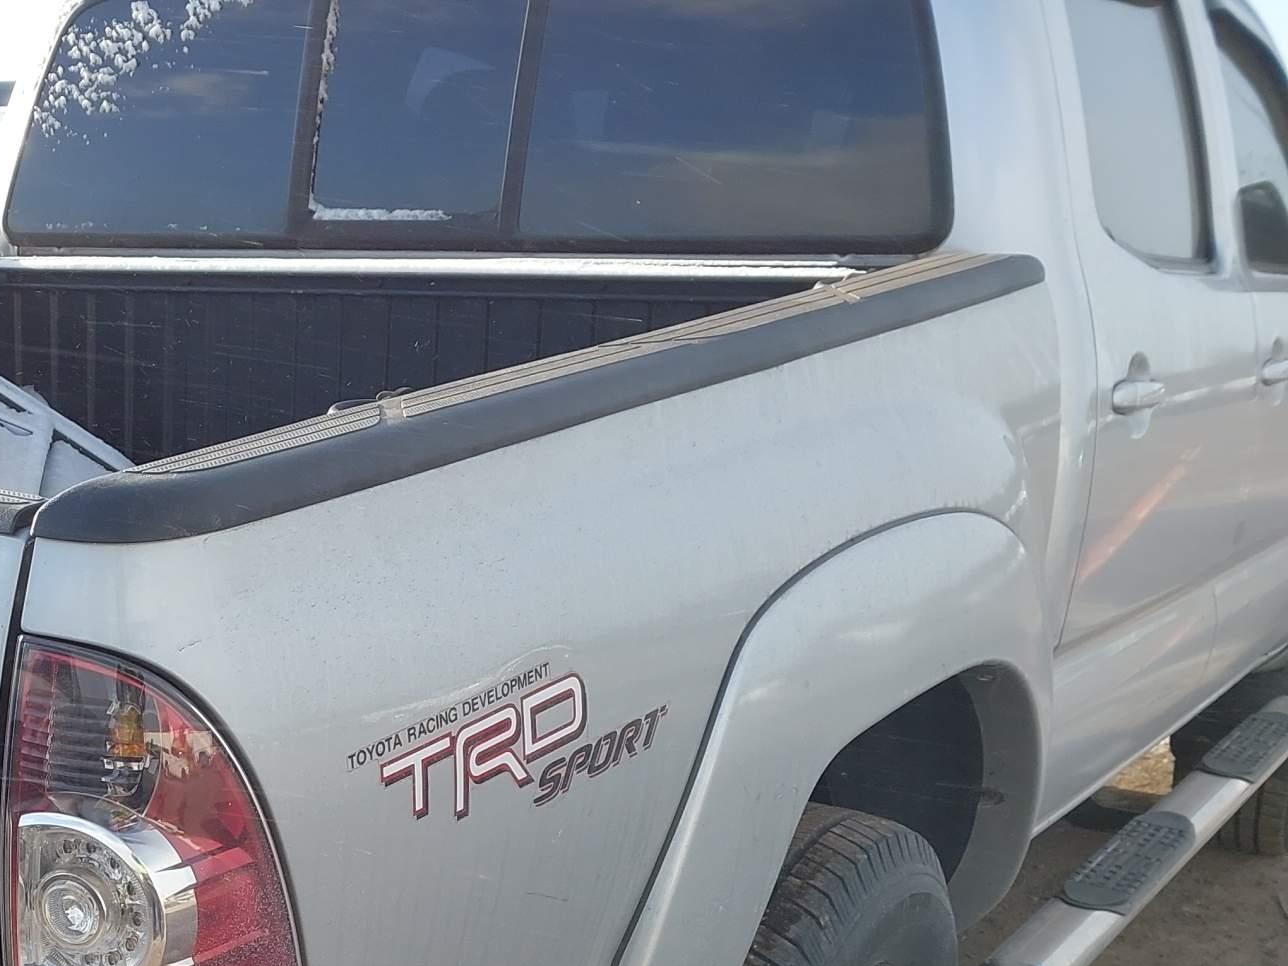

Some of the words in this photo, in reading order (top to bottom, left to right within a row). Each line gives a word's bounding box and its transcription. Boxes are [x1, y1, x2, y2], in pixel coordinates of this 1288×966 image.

[346, 735, 403, 769] TOYOTA
[407, 708, 458, 743] RACING
[462, 662, 551, 718] DEVELOPMENT
[380, 671, 588, 821] TRD
[533, 703, 669, 806] SPORT
